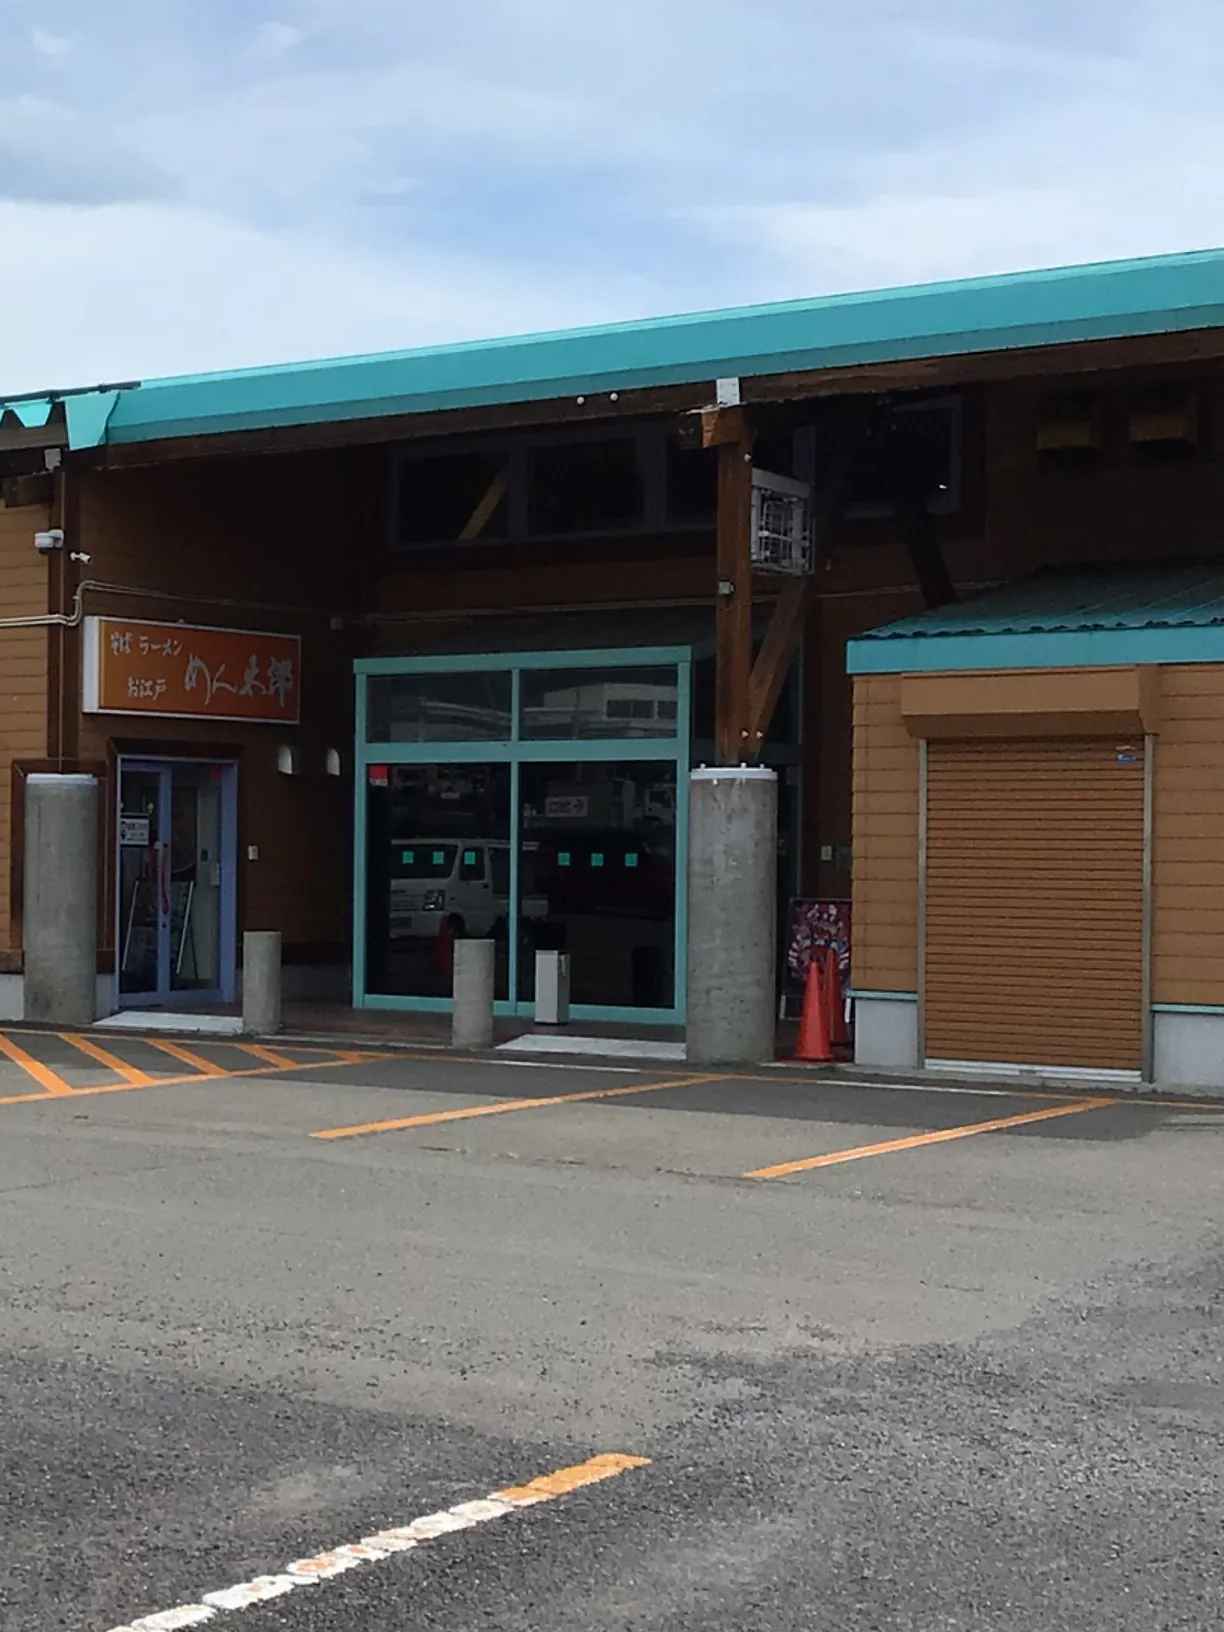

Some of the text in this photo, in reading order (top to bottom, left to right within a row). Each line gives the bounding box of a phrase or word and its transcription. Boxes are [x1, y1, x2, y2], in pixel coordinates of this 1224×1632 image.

[138, 635, 184, 656] ラーメン
[127, 675, 168, 701] お江戸
